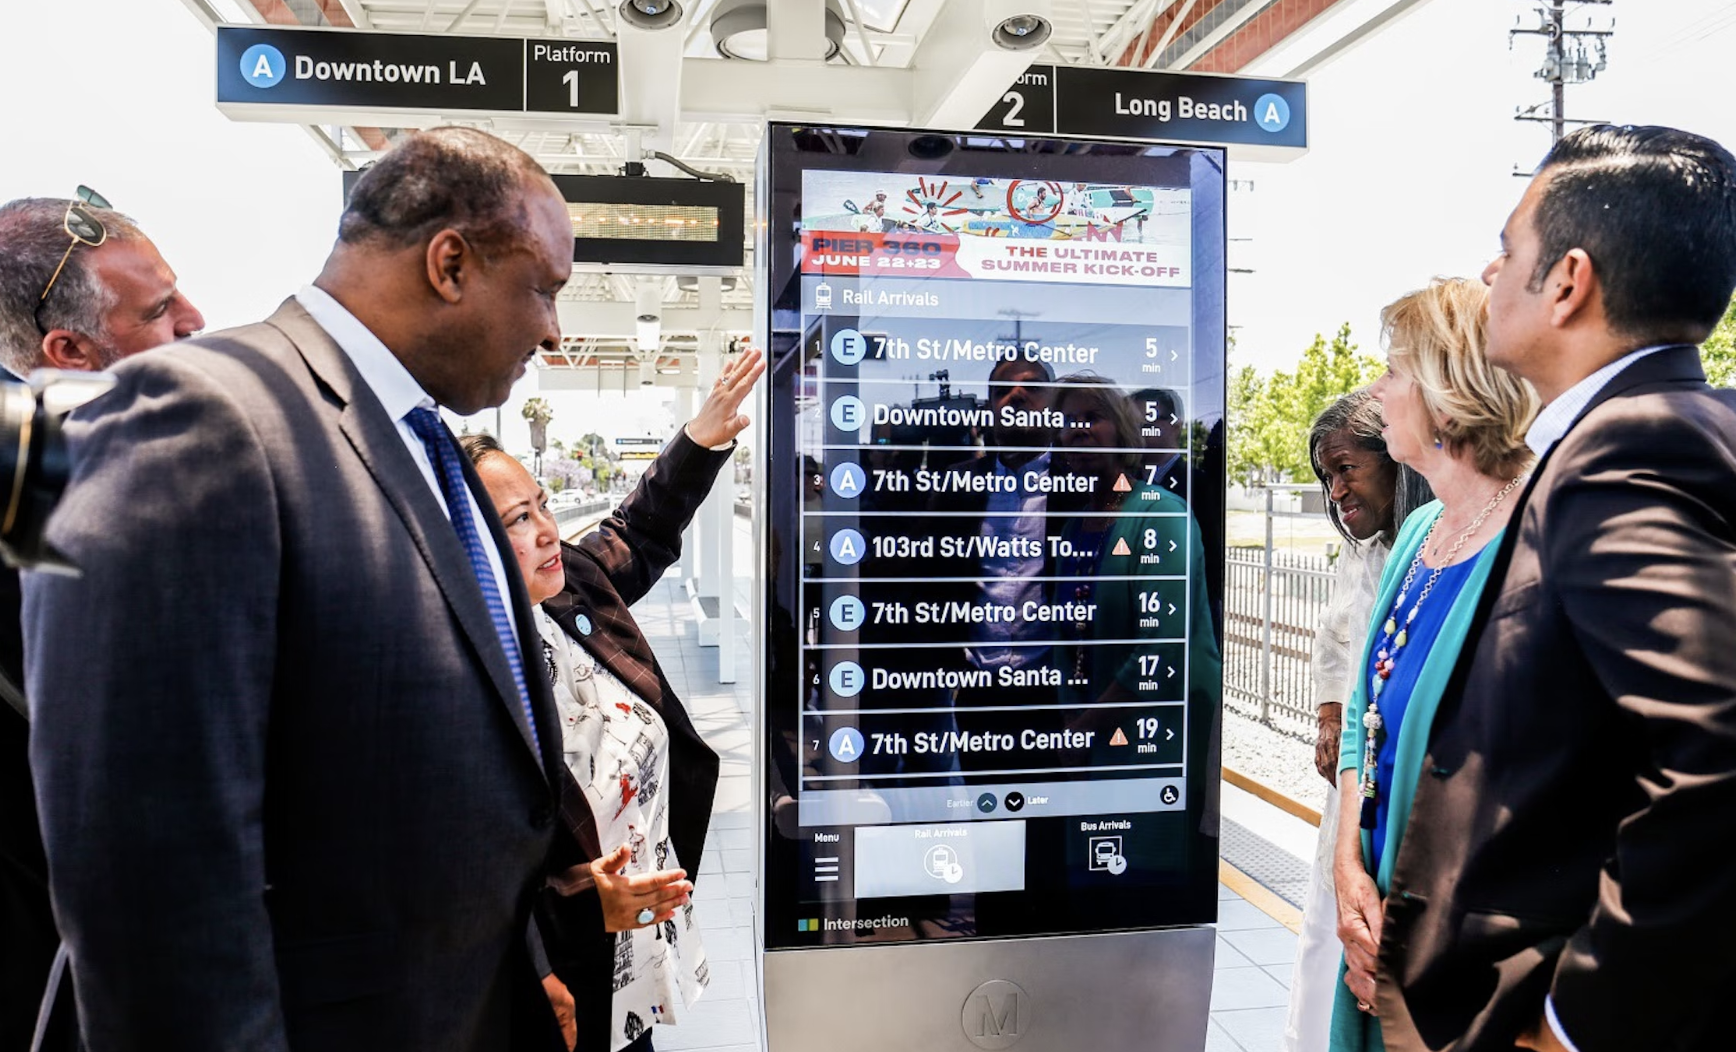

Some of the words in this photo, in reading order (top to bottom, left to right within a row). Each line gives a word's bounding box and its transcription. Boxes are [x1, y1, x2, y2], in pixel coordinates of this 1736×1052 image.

[534, 45, 610, 64] Platform
[252, 55, 273, 78] A
[296, 56, 440, 84] Downtown
[449, 61, 486, 86] LA
[562, 70, 579, 107] 1
[1003, 91, 1025, 127] 2
[1116, 93, 1171, 122] Long
[1178, 96, 1247, 122] Beach
[1264, 103, 1280, 124] A
[812, 238, 873, 254] PIER
[882, 240, 941, 256] 360
[1006, 246, 1048, 259] THE
[1054, 248, 1158, 263] ULTIMATE
[811, 254, 871, 268] JUNE
[877, 256, 942, 270] 22+23
[981, 259, 1077, 274] SUMMER
[1084, 263, 1180, 278] KICK-OFF
[843, 289, 873, 305] Rail
[878, 290, 939, 307] Arrivals
[842, 338, 855, 356] E
[874, 338, 910, 359] 7th
[916, 338, 1018, 363] St/Metro
[1023, 342, 1098, 364] Center
[1145, 338, 1158, 358] 5
[1142, 362, 1161, 373] min
[842, 404, 855, 423] E
[874, 404, 994, 426] Downtown
[1000, 406, 1065, 429] Santa
[1145, 402, 1158, 421] 5
[1142, 426, 1161, 437] min
[814, 474, 821, 486] 3
[839, 472, 857, 490] A
[874, 470, 909, 492] 7th
[916, 471, 1018, 493] St/Metro
[1023, 471, 1098, 493] Center
[1145, 466, 1158, 486] 7
[1141, 490, 1160, 501] min
[814, 542, 821, 553] 4
[839, 538, 857, 557] A
[873, 536, 934, 558] 103rd
[940, 536, 1042, 558] St/Watts
[1047, 536, 1093, 558] To...
[1144, 530, 1157, 549] 8
[1140, 553, 1159, 564] min
[813, 608, 820, 619] 5
[841, 604, 854, 622] E
[872, 602, 908, 624] 7th
[915, 602, 1016, 624] St/Metro
[1022, 601, 1097, 622] Center
[1138, 592, 1160, 612] 16
[1140, 616, 1159, 628] min
[813, 675, 820, 685] 6
[841, 670, 854, 688] E
[872, 667, 992, 690] Downtown
[998, 666, 1062, 687] Santa
[1138, 656, 1160, 676] 17
[1139, 680, 1158, 691] min
[813, 740, 820, 751] 7
[838, 736, 856, 754] A
[871, 733, 908, 755] 7th
[913, 732, 1015, 753] St/Metro
[1020, 729, 1095, 751] Center
[1136, 718, 1159, 738] 19
[1138, 742, 1157, 754] min
[947, 799, 974, 808] Earlier
[1027, 796, 1049, 805] Later
[915, 829, 932, 839] Rail
[934, 827, 967, 838] Arrivals
[1081, 821, 1098, 832] Bus
[1100, 819, 1131, 831] Arrivals
[814, 833, 840, 843] Menu
[824, 916, 909, 931] Intersection
[975, 992, 1018, 1037] M
